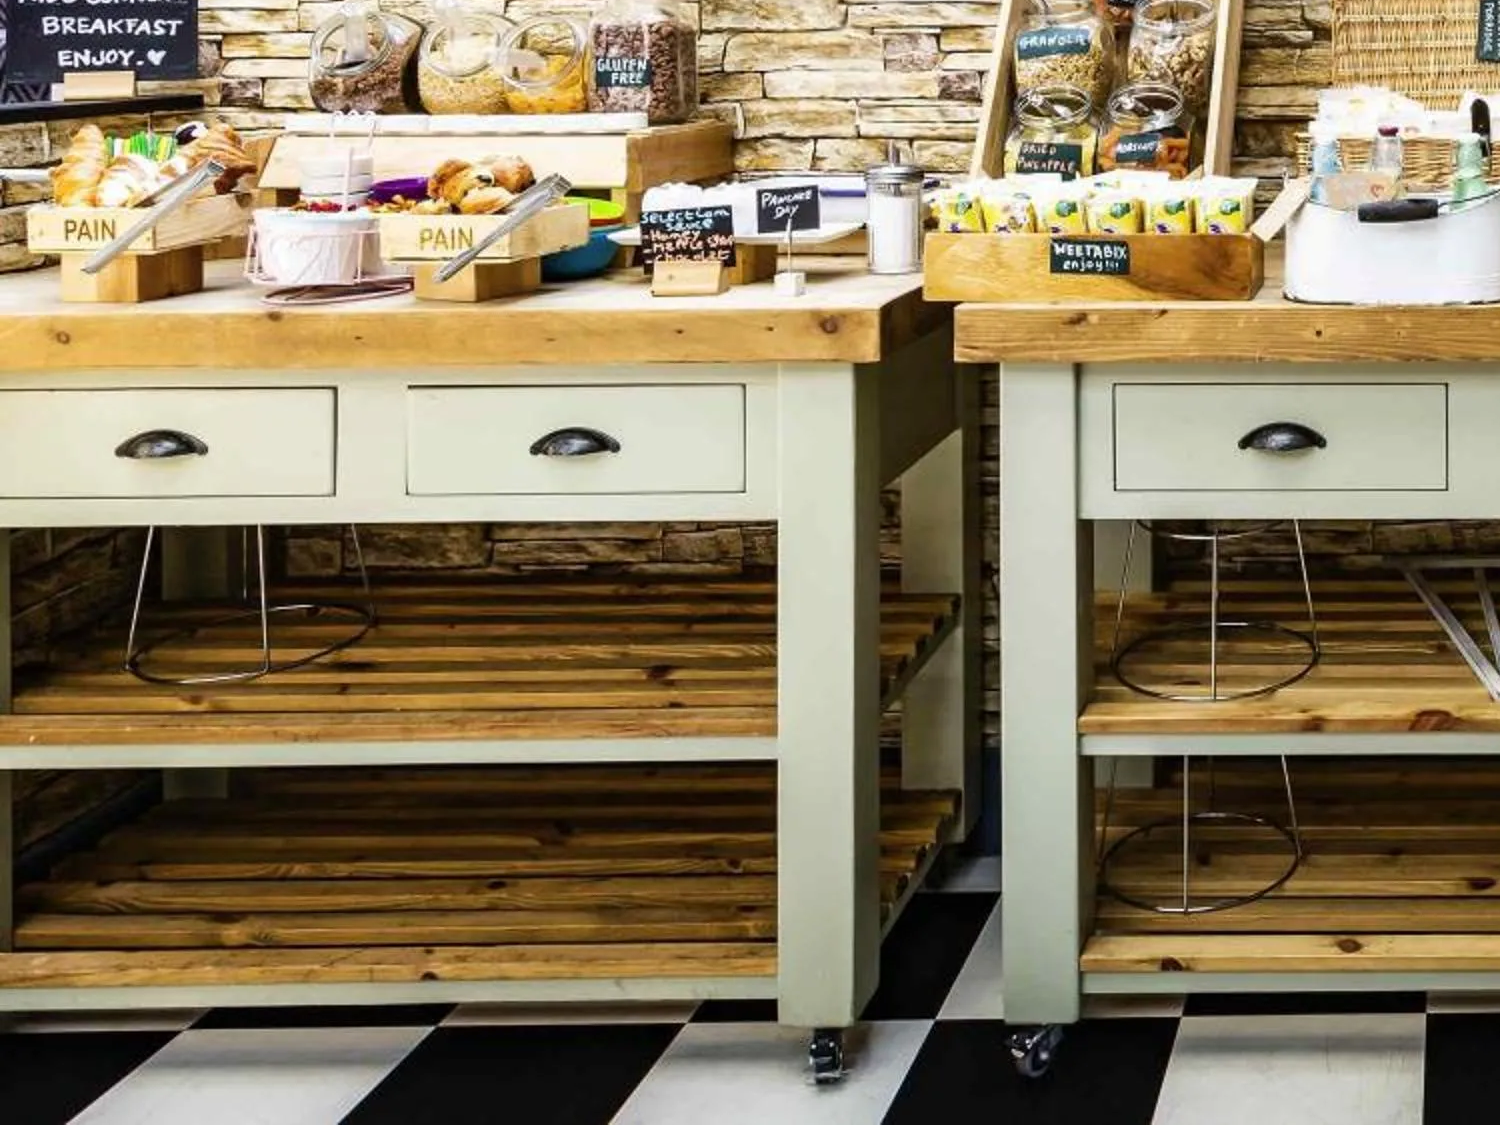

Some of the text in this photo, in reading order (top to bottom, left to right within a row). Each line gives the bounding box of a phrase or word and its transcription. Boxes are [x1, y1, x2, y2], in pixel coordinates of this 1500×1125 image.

[41, 16, 183, 36] BREAKFAST
[597, 58, 648, 72] GLUTEN
[611, 72, 644, 84] FREE
[773, 204, 799, 220] DAY
[64, 218, 116, 242] PAIN
[419, 226, 474, 251] PAIN
[1054, 242, 1127, 260] WEETABIX
